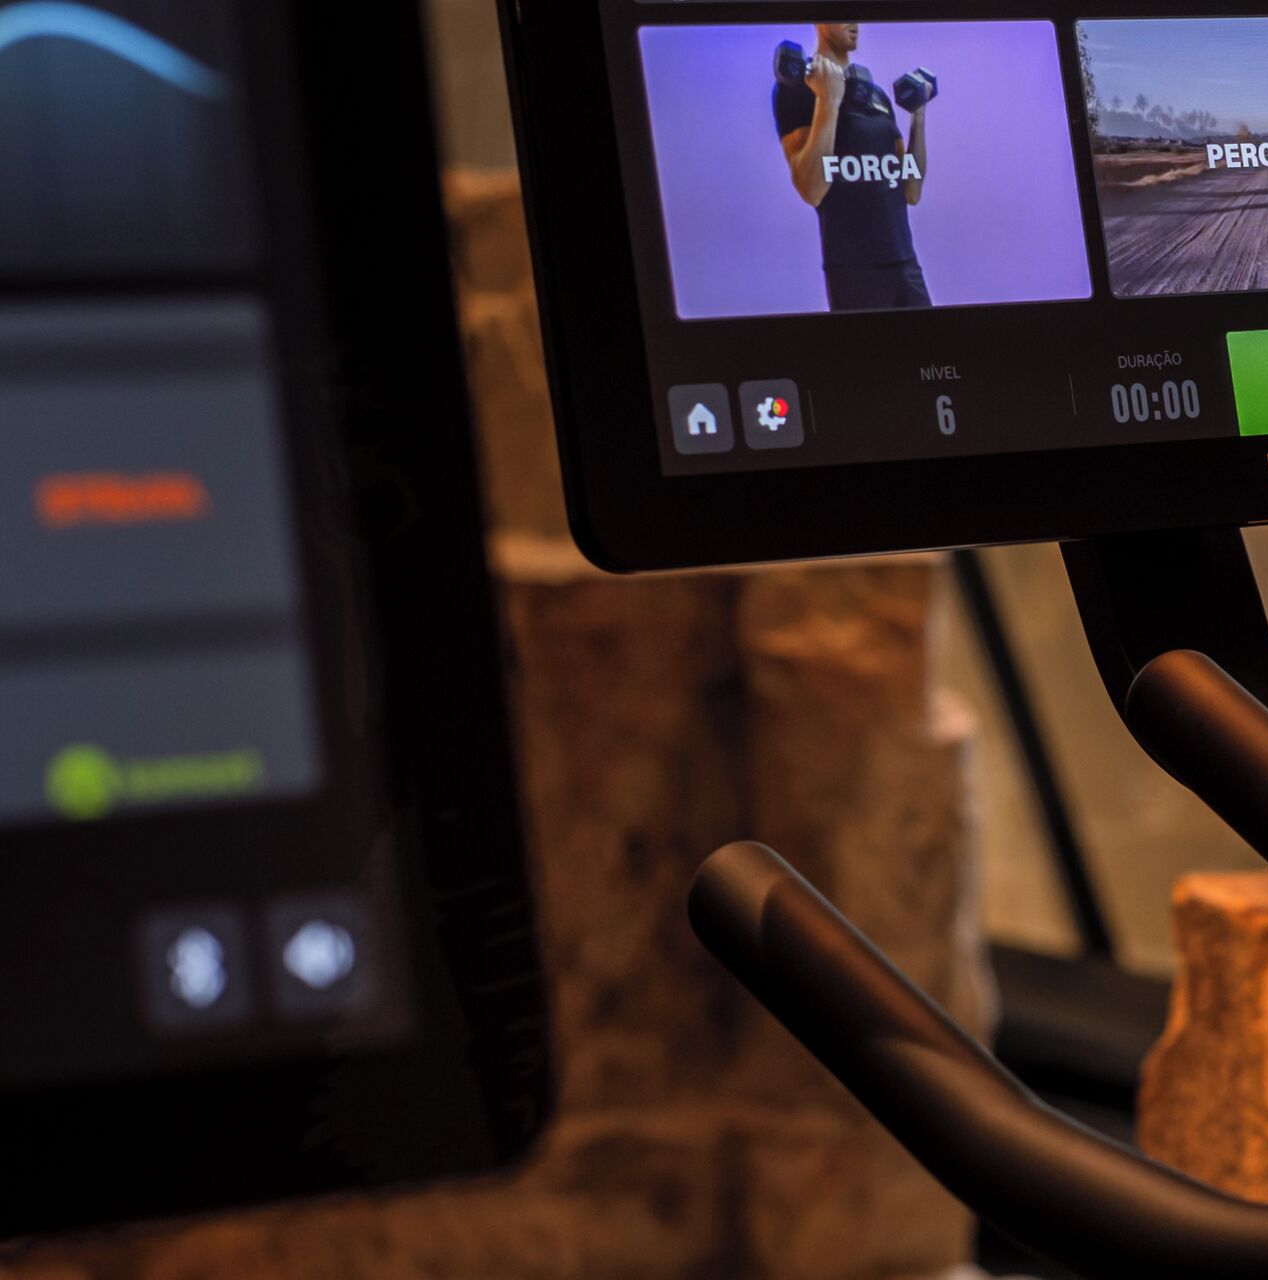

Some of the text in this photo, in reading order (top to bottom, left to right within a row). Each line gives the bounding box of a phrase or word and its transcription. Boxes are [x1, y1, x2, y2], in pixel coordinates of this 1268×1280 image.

[822, 153, 922, 189] FORÇA
[920, 364, 961, 381] NÍVEL
[1117, 350, 1182, 370] DURAÇÃO
[936, 395, 956, 435] 6
[1110, 379, 1200, 423] 00:00
